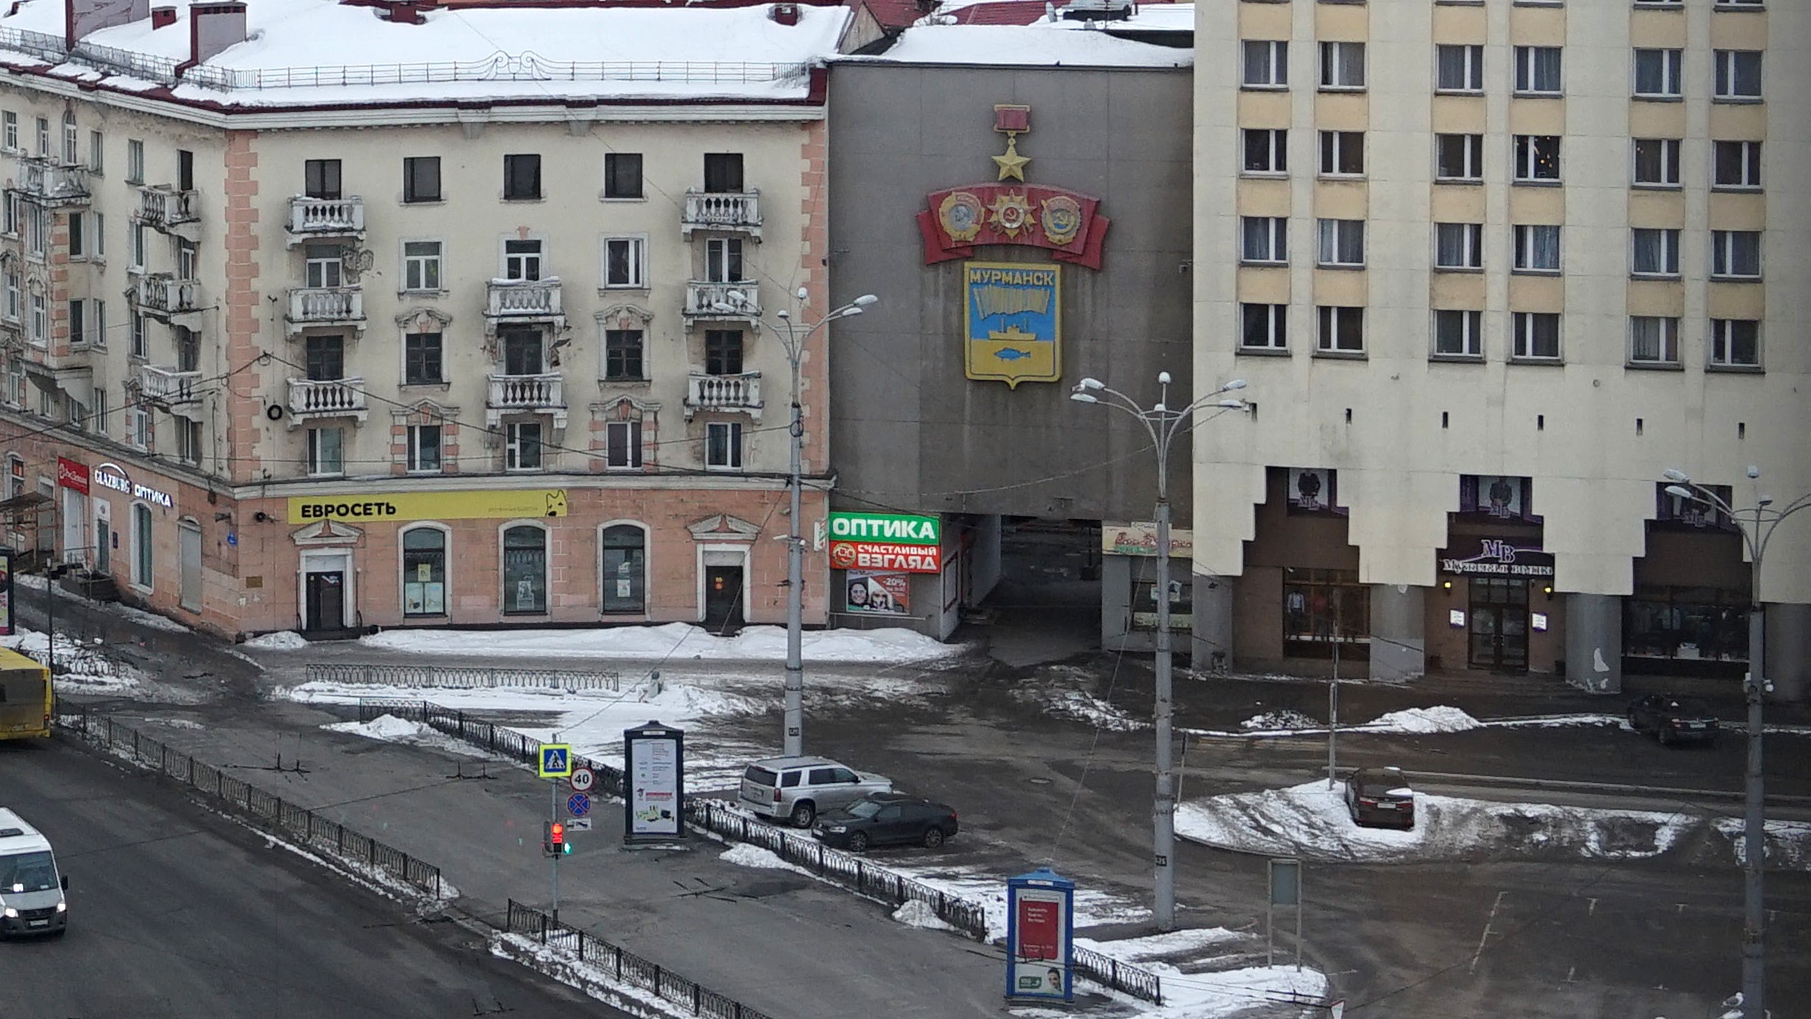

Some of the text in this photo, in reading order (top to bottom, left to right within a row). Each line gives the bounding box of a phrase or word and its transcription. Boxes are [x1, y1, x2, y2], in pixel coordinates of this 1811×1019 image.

[969, 269, 1055, 286] МУРМАНСК
[134, 483, 172, 508] ОПТИКА
[301, 502, 396, 518] ЕВРОСЕТЬ
[832, 517, 936, 540] ОПТИКА
[857, 544, 937, 555] СЧАСТЛИВЫЙ
[857, 555, 937, 570] ВЗГЛЯД
[574, 773, 590, 785] 40
